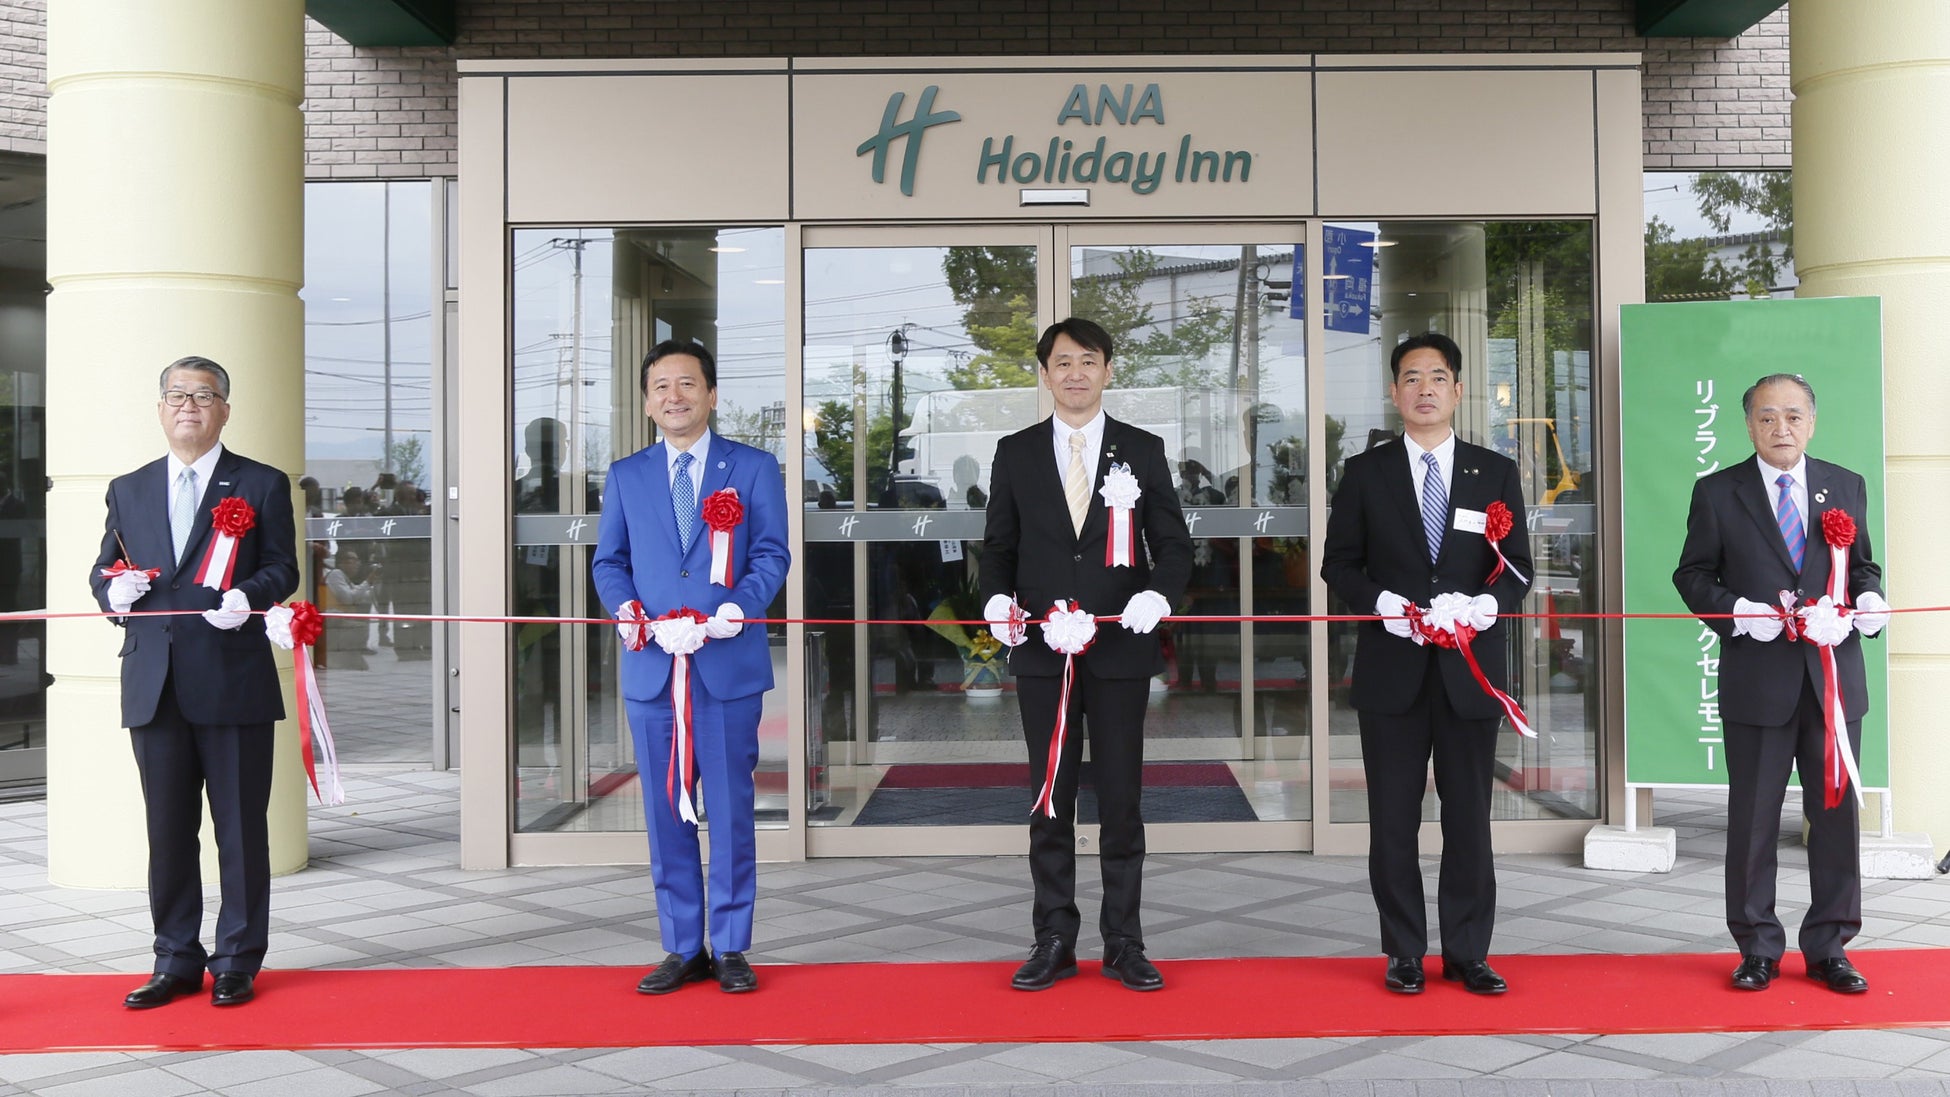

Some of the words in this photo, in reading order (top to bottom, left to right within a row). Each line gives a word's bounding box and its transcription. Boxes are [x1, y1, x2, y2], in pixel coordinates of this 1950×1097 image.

[1057, 83, 1165, 125] ANA
[977, 135, 1166, 194] Holiday
[1174, 134, 1252, 182] Inn
[1695, 380, 1719, 477] リブラン
